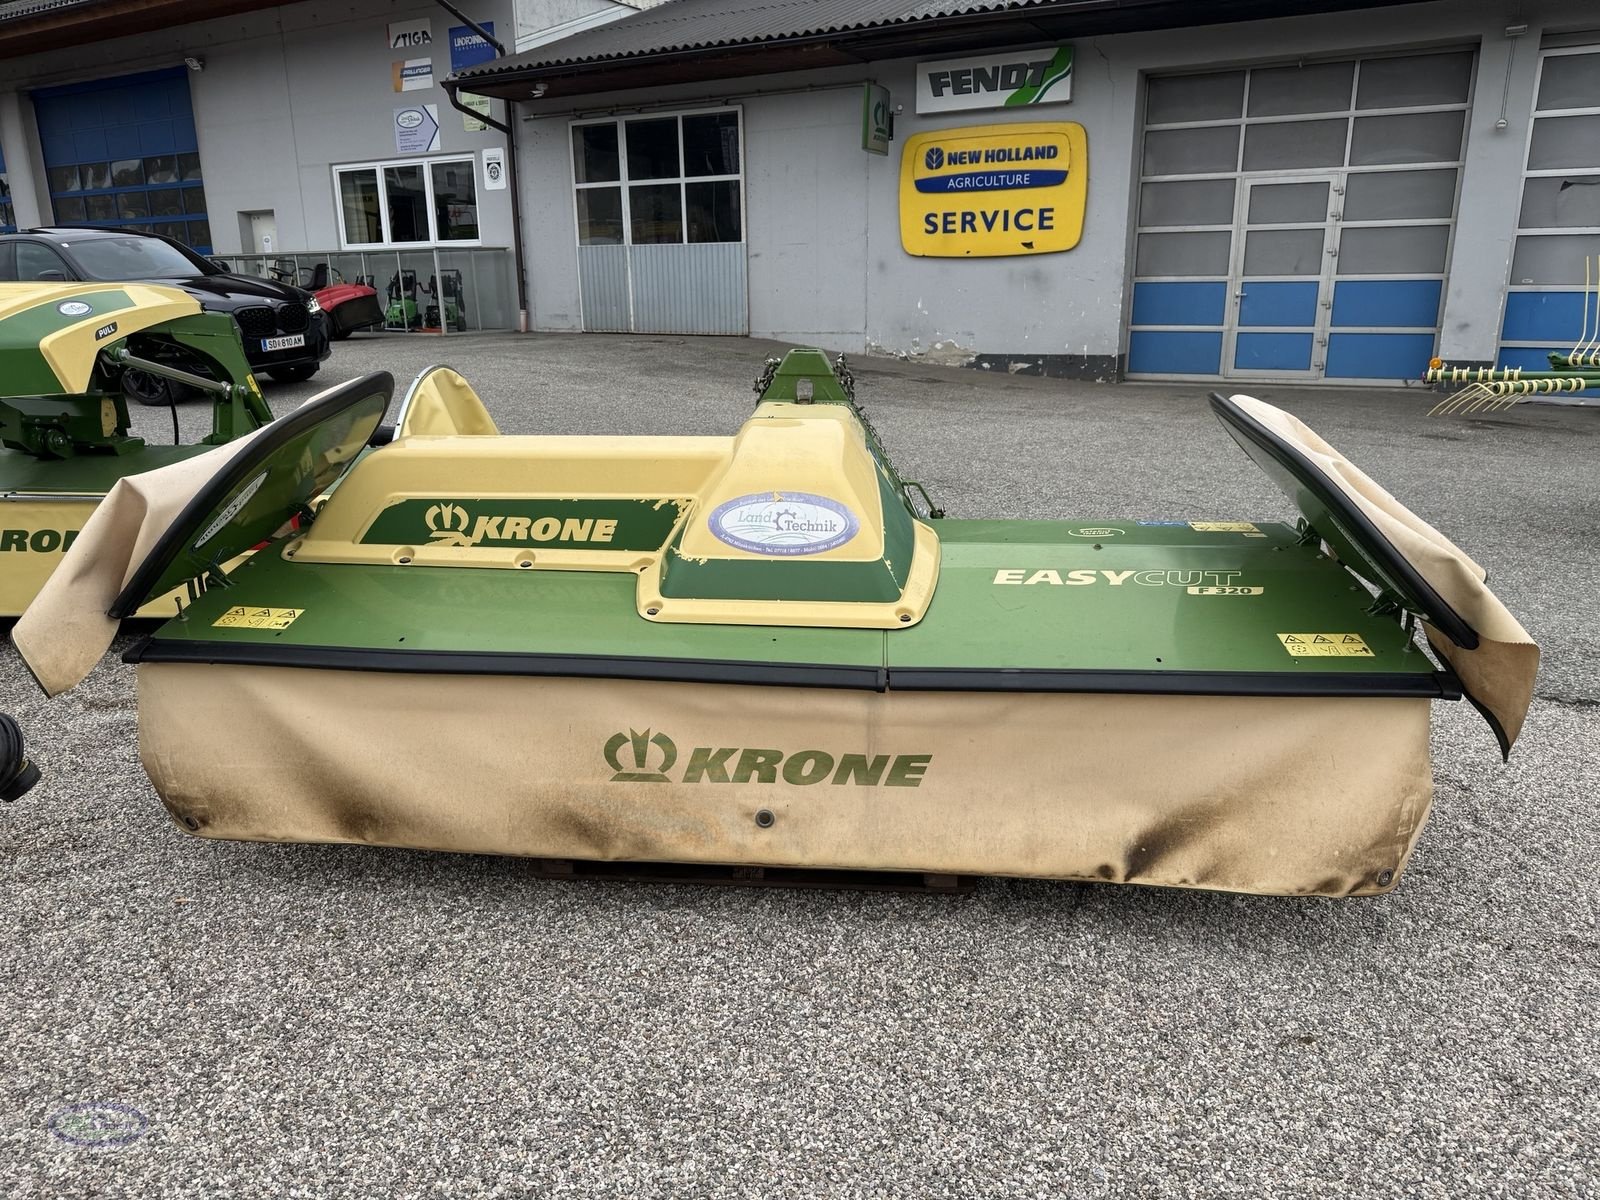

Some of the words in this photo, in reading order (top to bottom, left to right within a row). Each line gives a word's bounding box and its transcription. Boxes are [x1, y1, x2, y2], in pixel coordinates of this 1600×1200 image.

[393, 30, 432, 48] STIGA
[928, 60, 1054, 97] FENDT
[947, 150, 981, 166] NEW
[985, 145, 1058, 164] HOLLAND
[947, 173, 1031, 189] AGRICULTURE
[924, 207, 1055, 235] SERVICE
[98, 324, 115, 338] PULL
[738, 510, 773, 523] Land
[785, 519, 838, 532] Technik
[471, 515, 618, 543] KRONE
[993, 569, 1242, 587] EASYCUT
[1198, 587, 1209, 595] F
[1215, 587, 1252, 595] 320
[682, 747, 933, 787] KRONE
